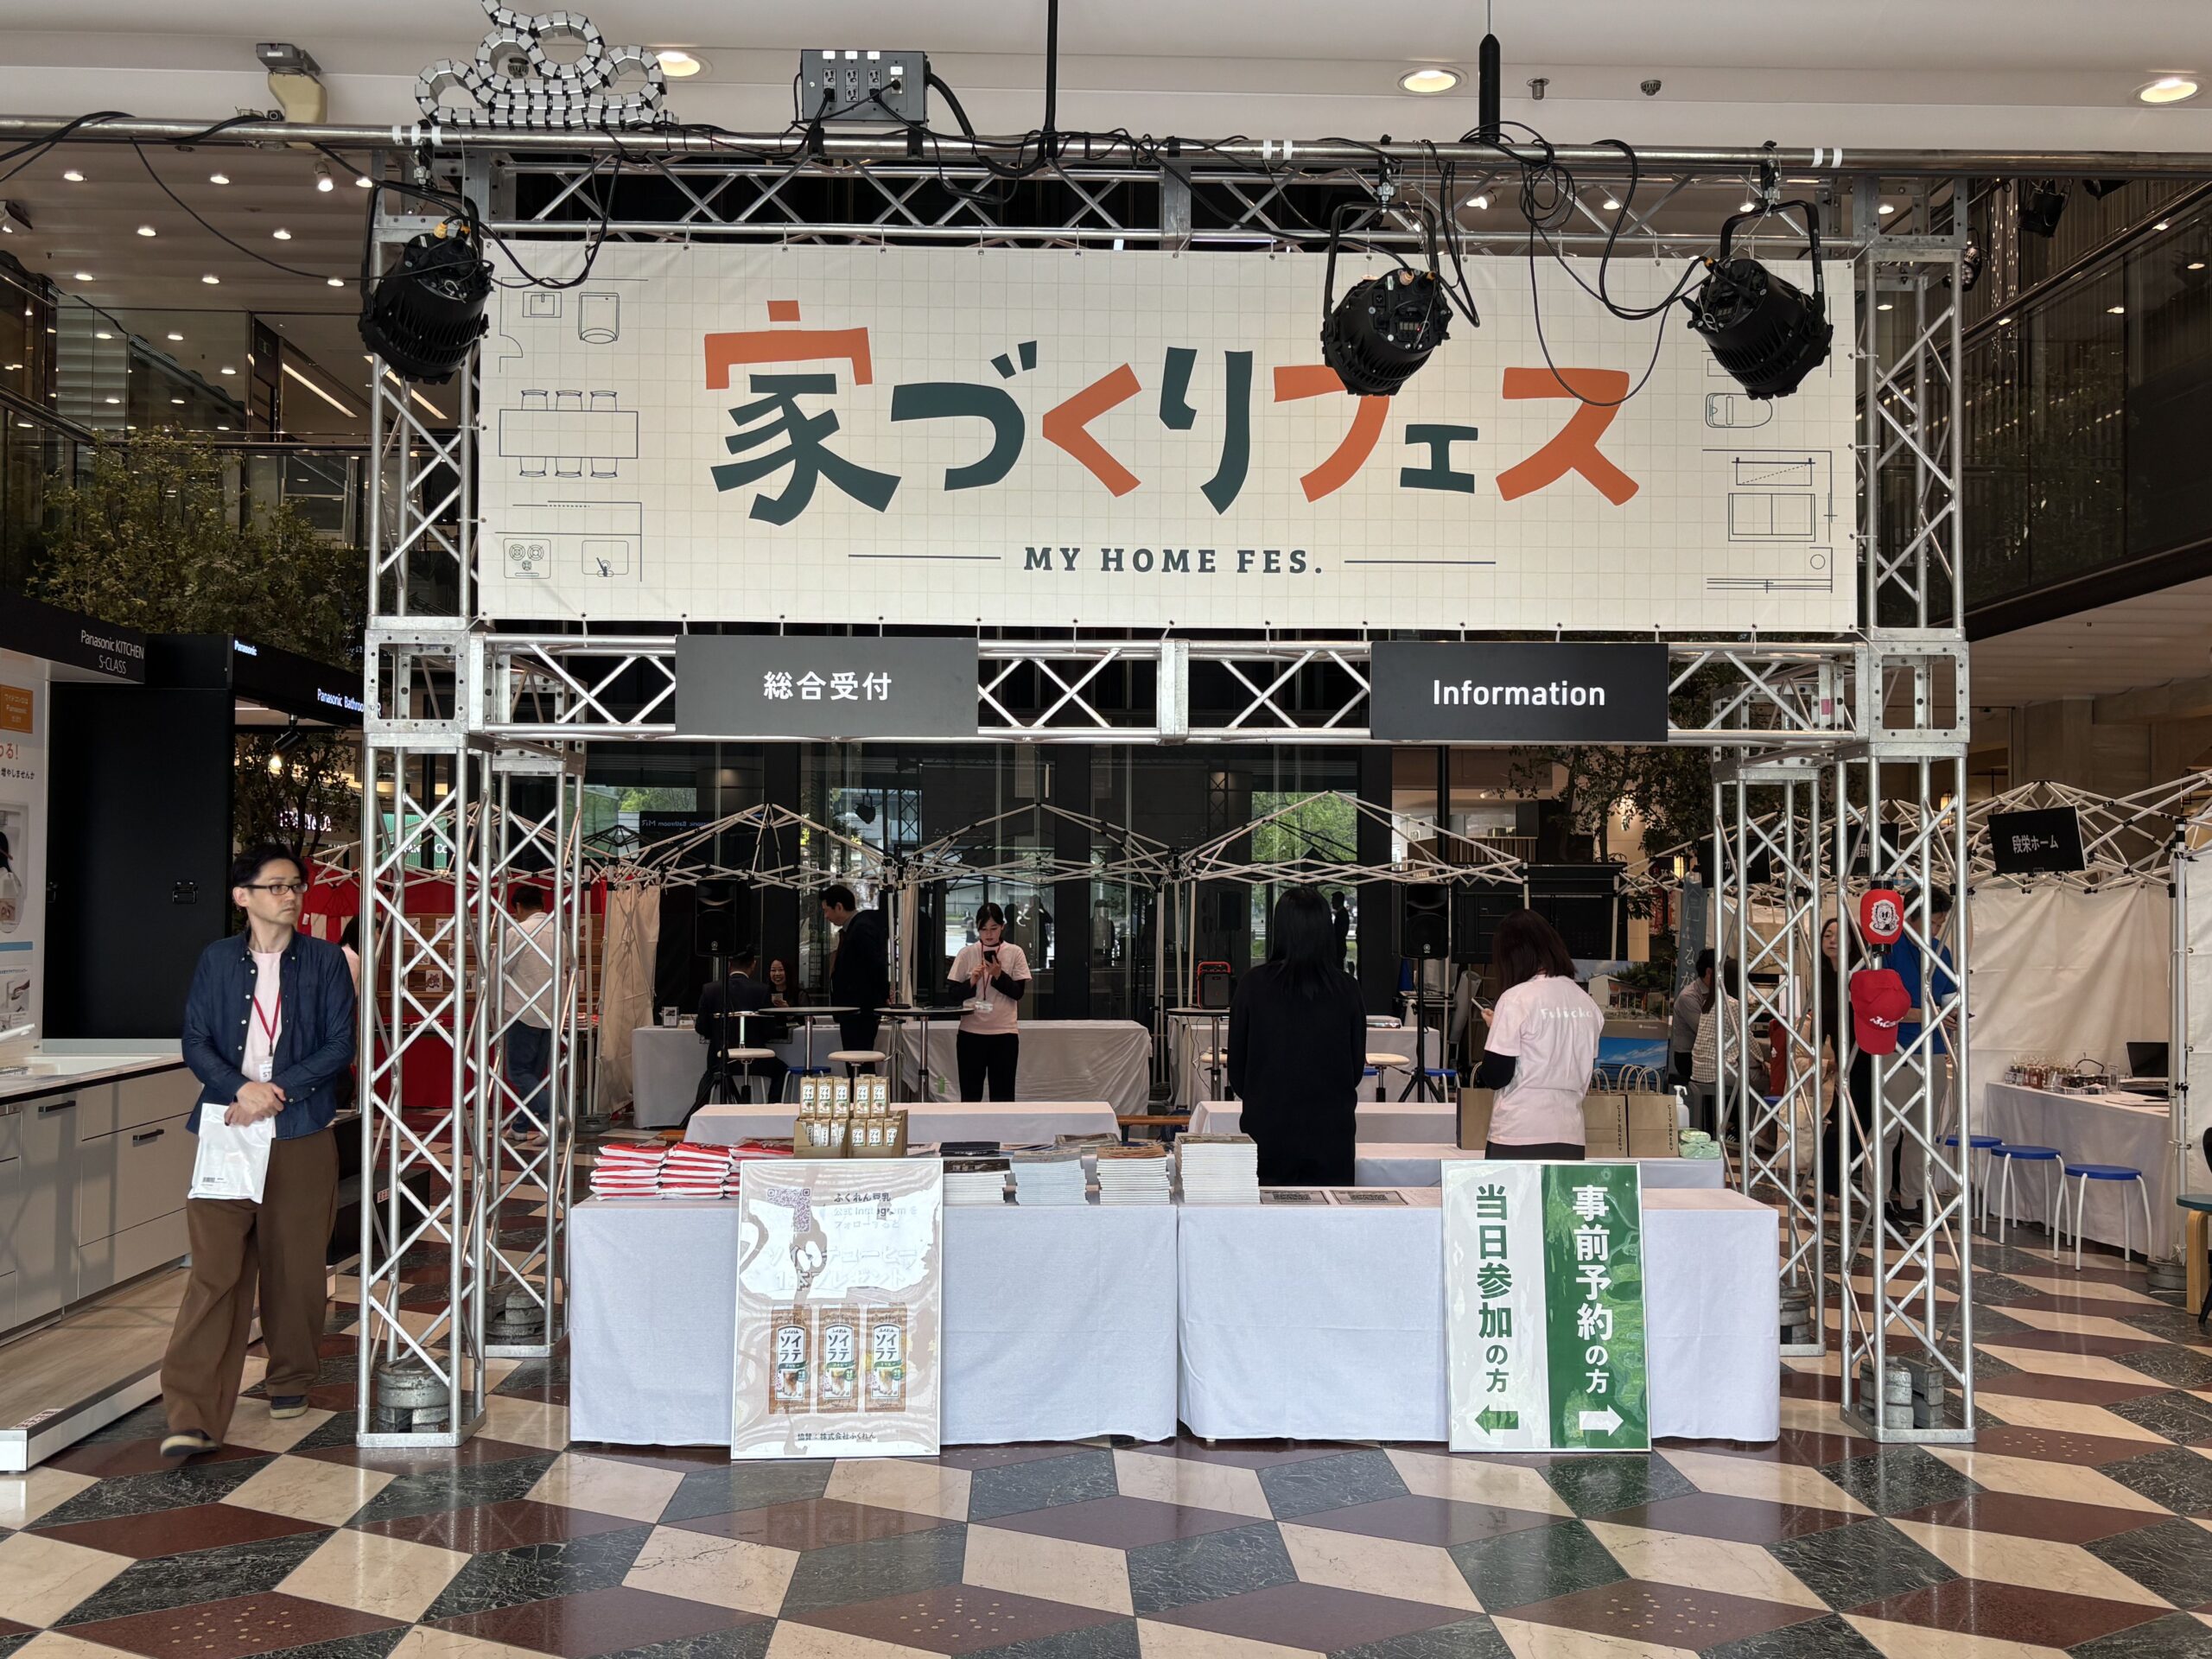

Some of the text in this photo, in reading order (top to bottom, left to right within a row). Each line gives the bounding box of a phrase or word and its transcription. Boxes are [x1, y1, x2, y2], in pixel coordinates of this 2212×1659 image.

[704, 300, 1640, 526] 家づくりフェス
[1023, 547, 1323, 574] MY HOME FES.
[80, 629, 144, 660] Panasonic KITCHEN
[234, 639, 257, 657] Panasonic
[99, 654, 127, 674] S-CLASS
[763, 671, 892, 701] 総合受付
[1433, 679, 1605, 706] Information
[317, 688, 343, 707] Panasonic
[344, 696, 365, 713] Bathroo
[833, 1192, 892, 1203] ふくれん豆乳
[1476, 1183, 1513, 1394] 当日参加の方
[1572, 1184, 1613, 1395] 事前予約の方
[780, 1335, 801, 1348] ソイ
[828, 1334, 849, 1347] ソイ
[875, 1334, 897, 1347] ソイ
[779, 1349, 801, 1362] ラテ
[827, 1348, 849, 1361] ラテ
[874, 1348, 897, 1361] ラテ
